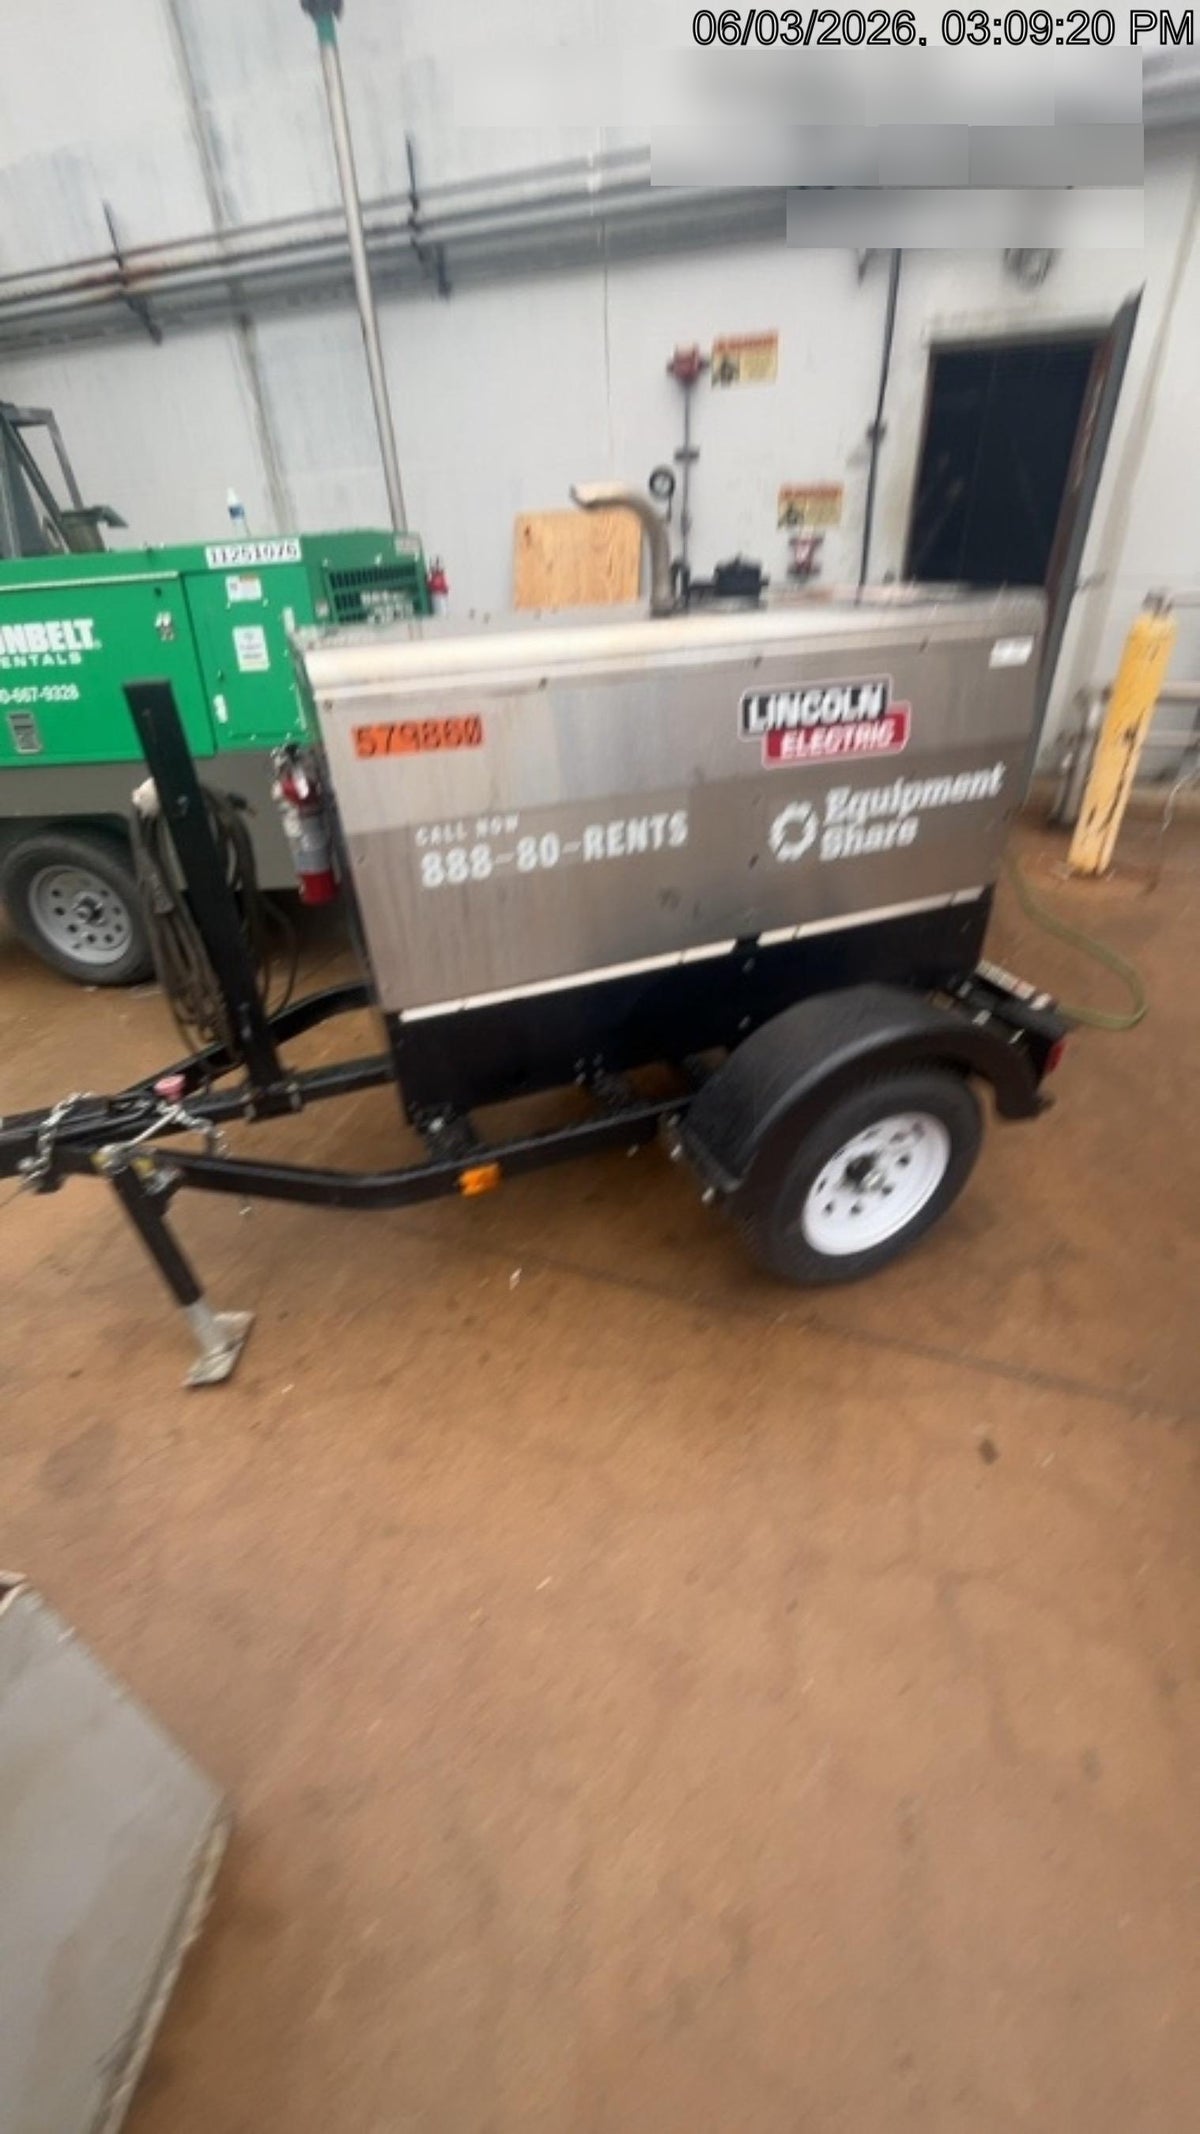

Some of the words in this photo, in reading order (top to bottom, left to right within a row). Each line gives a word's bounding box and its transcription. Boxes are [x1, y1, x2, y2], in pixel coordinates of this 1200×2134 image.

[0, 619, 93, 655] NBELT
[749, 682, 883, 733] LINCOLN
[355, 717, 482, 758] 579860
[780, 717, 896, 760] ELECTRIC
[823, 760, 1006, 826] Equipment
[415, 821, 467, 847] CALL
[476, 814, 519, 839] NOW
[420, 809, 689, 888] 888-80-RENTS
[819, 815, 919, 861] Share
